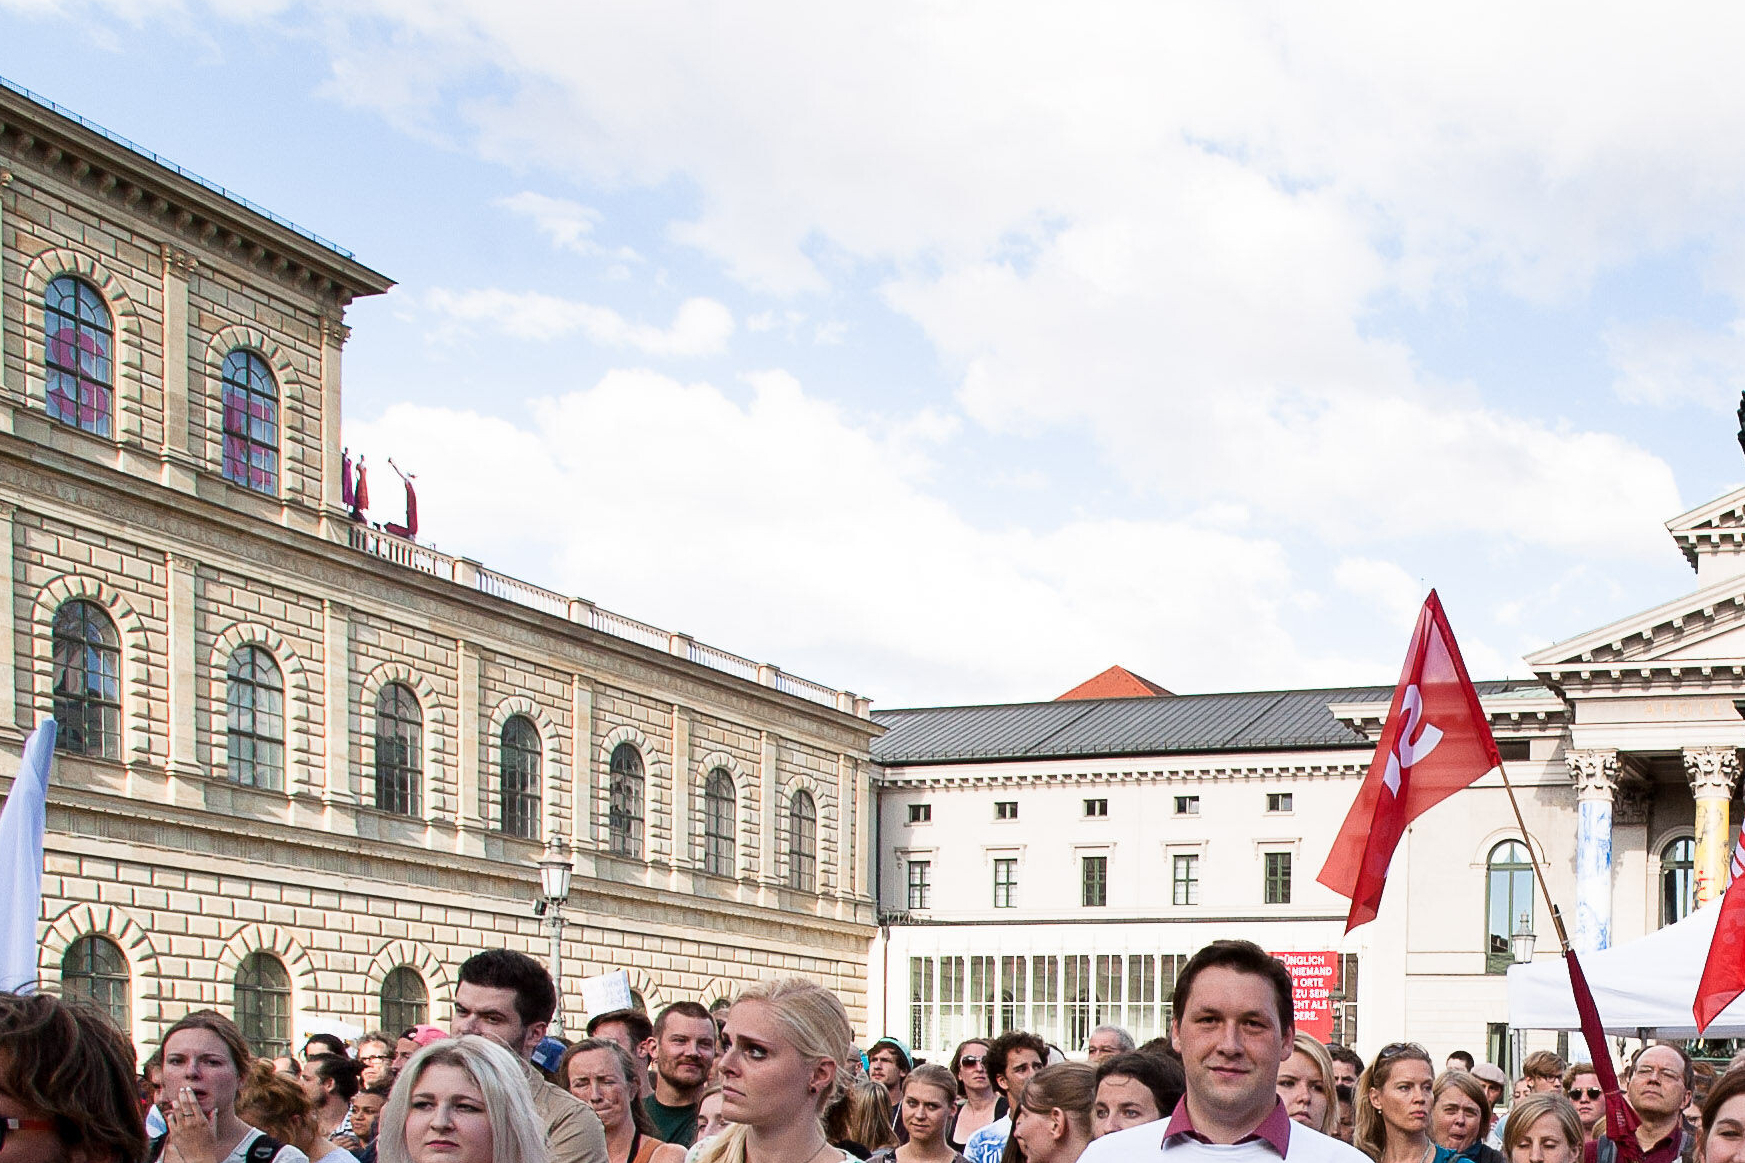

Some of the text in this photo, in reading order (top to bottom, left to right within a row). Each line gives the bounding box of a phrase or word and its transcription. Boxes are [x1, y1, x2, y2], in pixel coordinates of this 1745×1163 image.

[1300, 977, 1325, 988] ORTE
[1295, 988, 1308, 999] ZU
[1311, 1000, 1328, 1010] ALS
